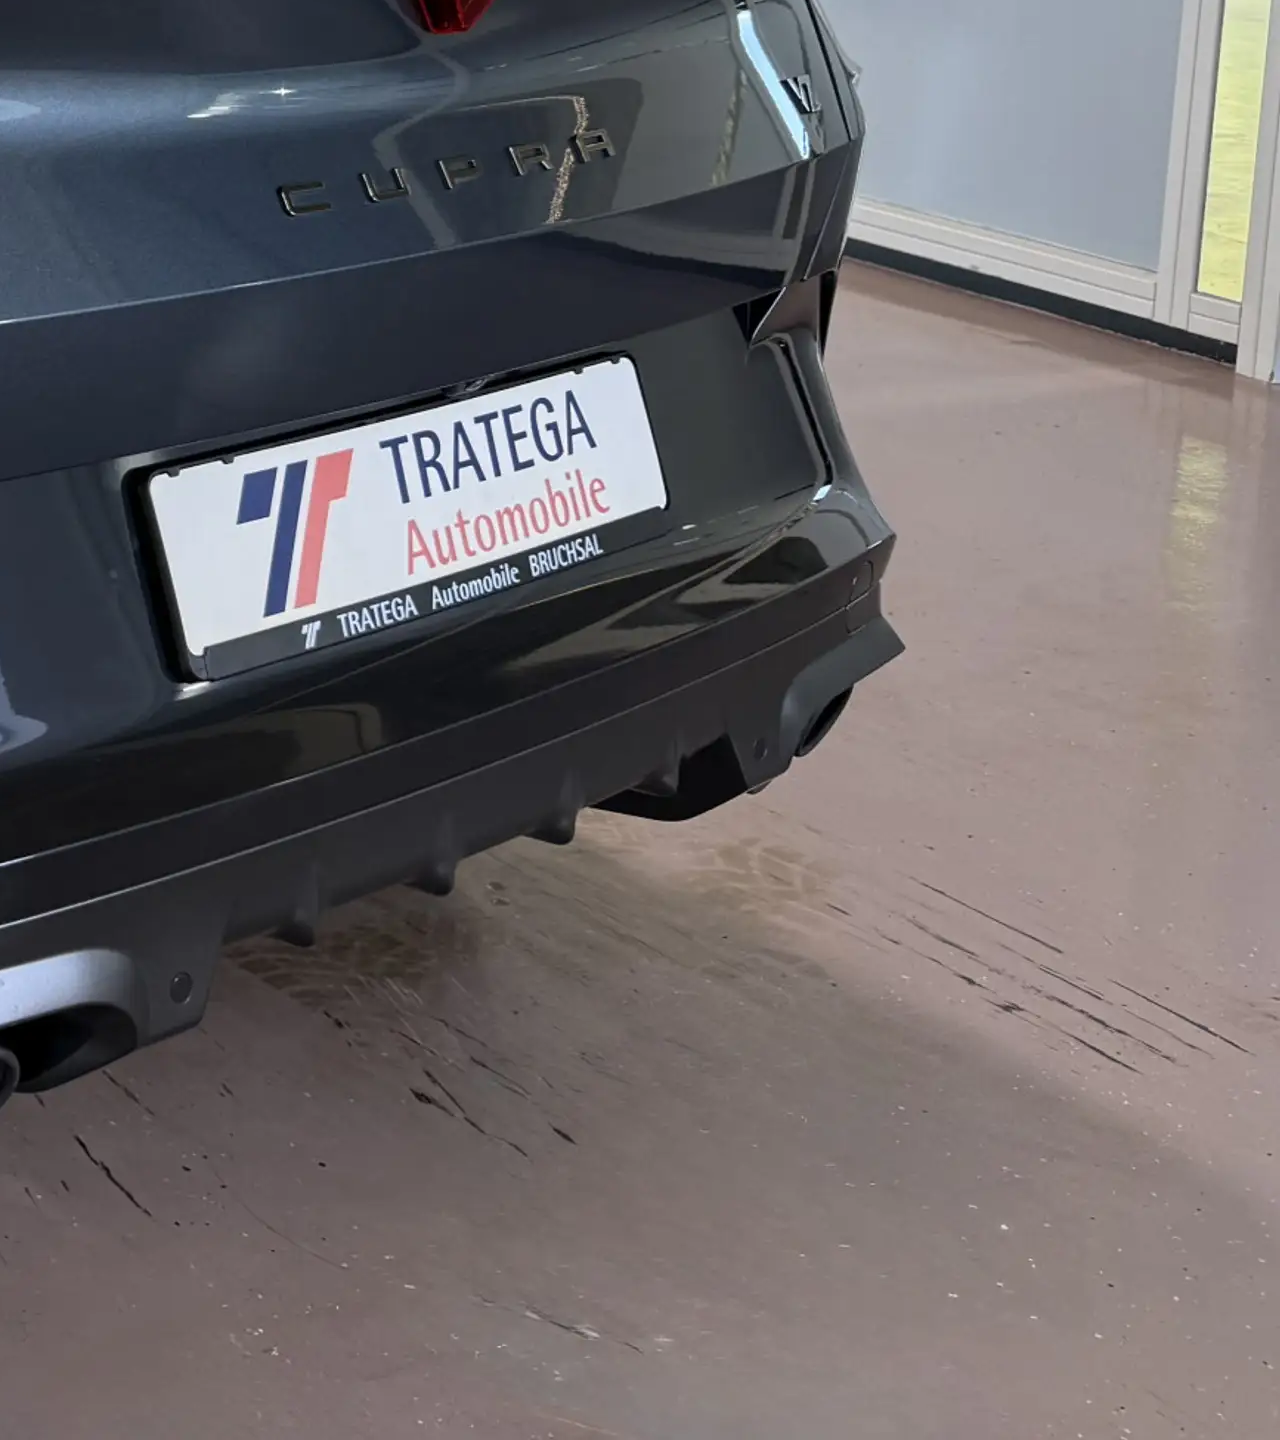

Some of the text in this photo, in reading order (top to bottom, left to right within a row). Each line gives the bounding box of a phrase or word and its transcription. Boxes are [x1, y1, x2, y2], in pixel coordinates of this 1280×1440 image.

[277, 127, 616, 217] CUPRA
[379, 389, 597, 504] TRATEGA
[406, 468, 611, 576] Automobile
[336, 534, 604, 638] TRATEGA Automobile BRUCHSAL
